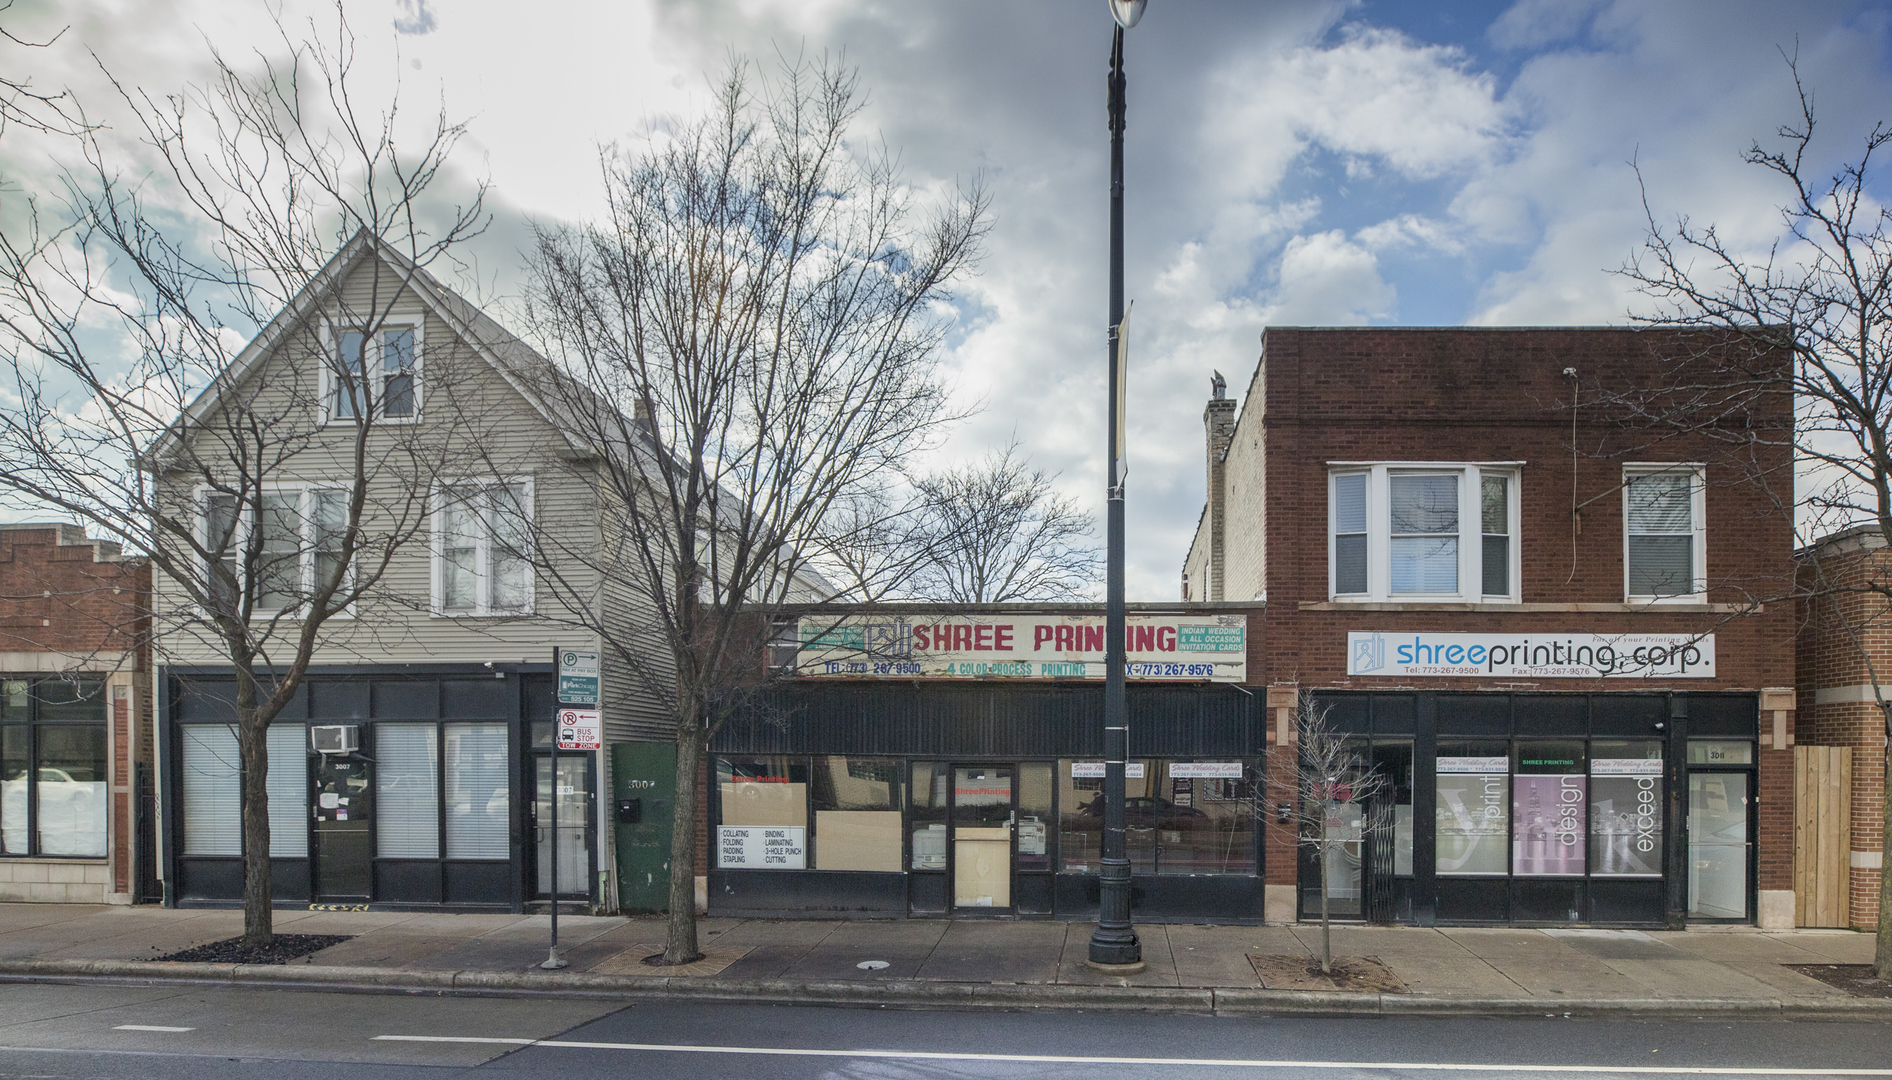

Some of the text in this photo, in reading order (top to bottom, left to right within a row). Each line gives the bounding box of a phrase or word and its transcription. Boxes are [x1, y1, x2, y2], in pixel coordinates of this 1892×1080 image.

[1181, 627, 1240, 635] INDIAN WEDDING
[912, 624, 1176, 652] SHREE PRINING
[1181, 635, 1242, 643] & ALL OCCASION
[1645, 636, 1681, 644] Printing
[1179, 643, 1243, 651] INVITATION CARDS
[873, 662, 921, 674] 267-9500
[947, 662, 1086, 676] 4 COLOR PROCESS PRINTING
[1165, 663, 1213, 676] 267-9576
[1404, 666, 1480, 675] Tel: 773-267-9500
[1512, 667, 1590, 675] Fax: 773-267-9576
[1458, 758, 1486, 767] Wedding
[1613, 760, 1641, 768] Wedding
[1192, 763, 1221, 772] Wedding
[757, 775, 788, 784] Printing
[1480, 775, 1505, 818] print
[1556, 775, 1583, 845] design
[1633, 776, 1654, 852] exceed
[723, 838, 743, 846] FOLDING
[765, 847, 783, 855] 3-HOLE
[723, 855, 745, 863] STAPLING
